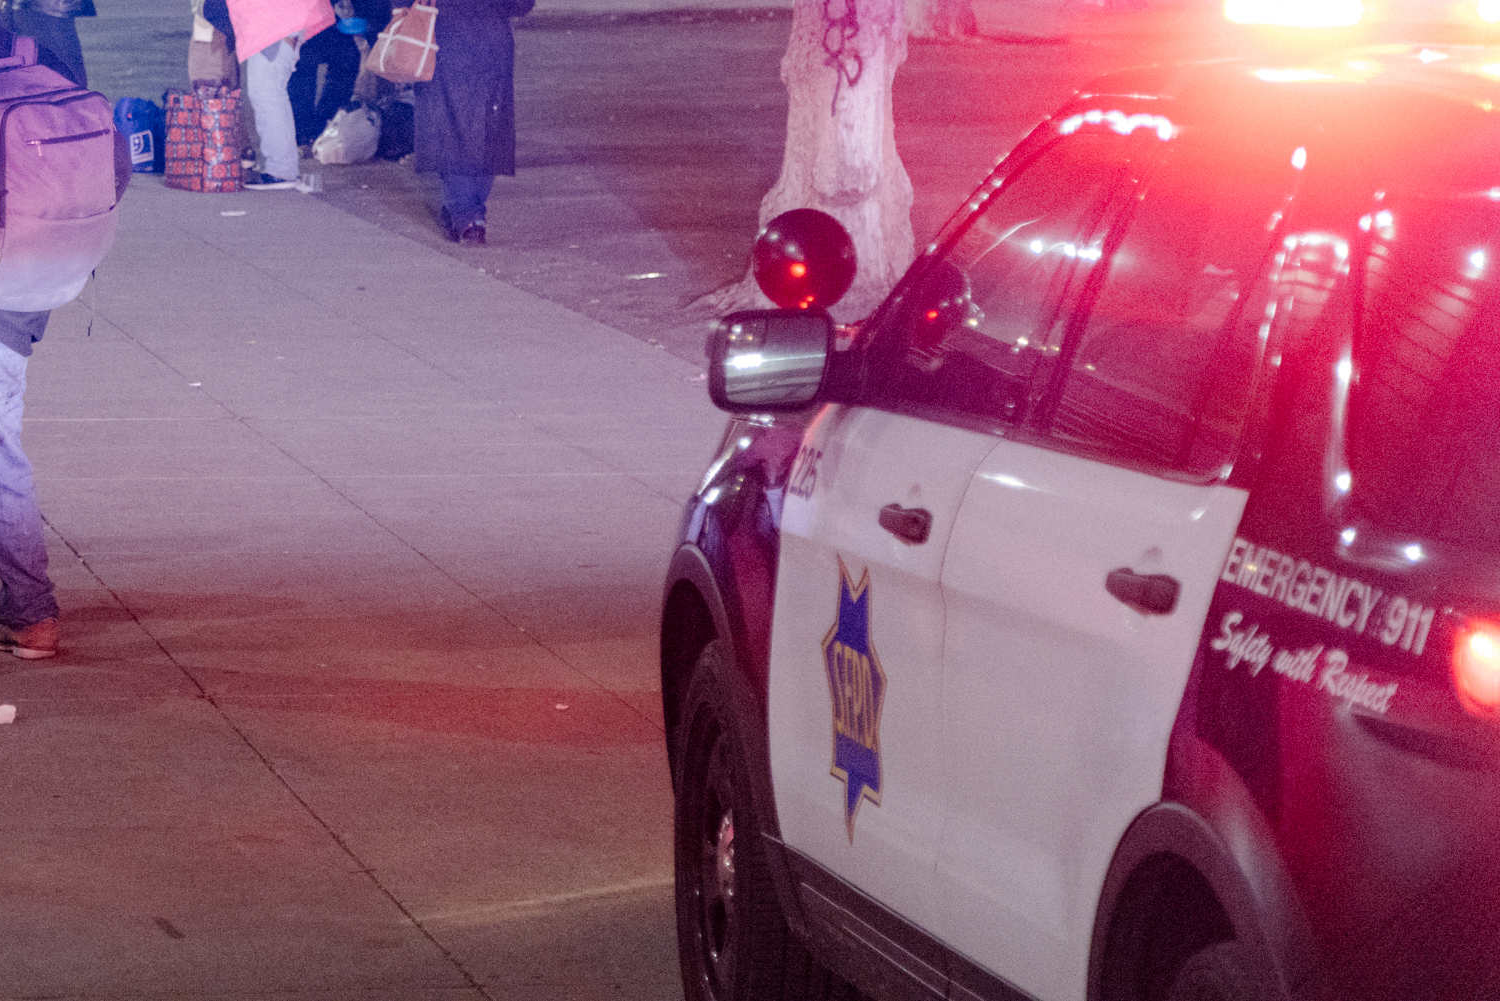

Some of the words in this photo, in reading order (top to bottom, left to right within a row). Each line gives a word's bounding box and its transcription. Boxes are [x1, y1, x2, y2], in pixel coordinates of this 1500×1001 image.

[1221, 538, 1383, 633] EMERGENCY
[1382, 597, 1435, 656] 911
[834, 641, 876, 751] SFPD
[1212, 612, 1274, 677] Safety
[1273, 646, 1325, 683] with
[1320, 650, 1399, 714] Respect
